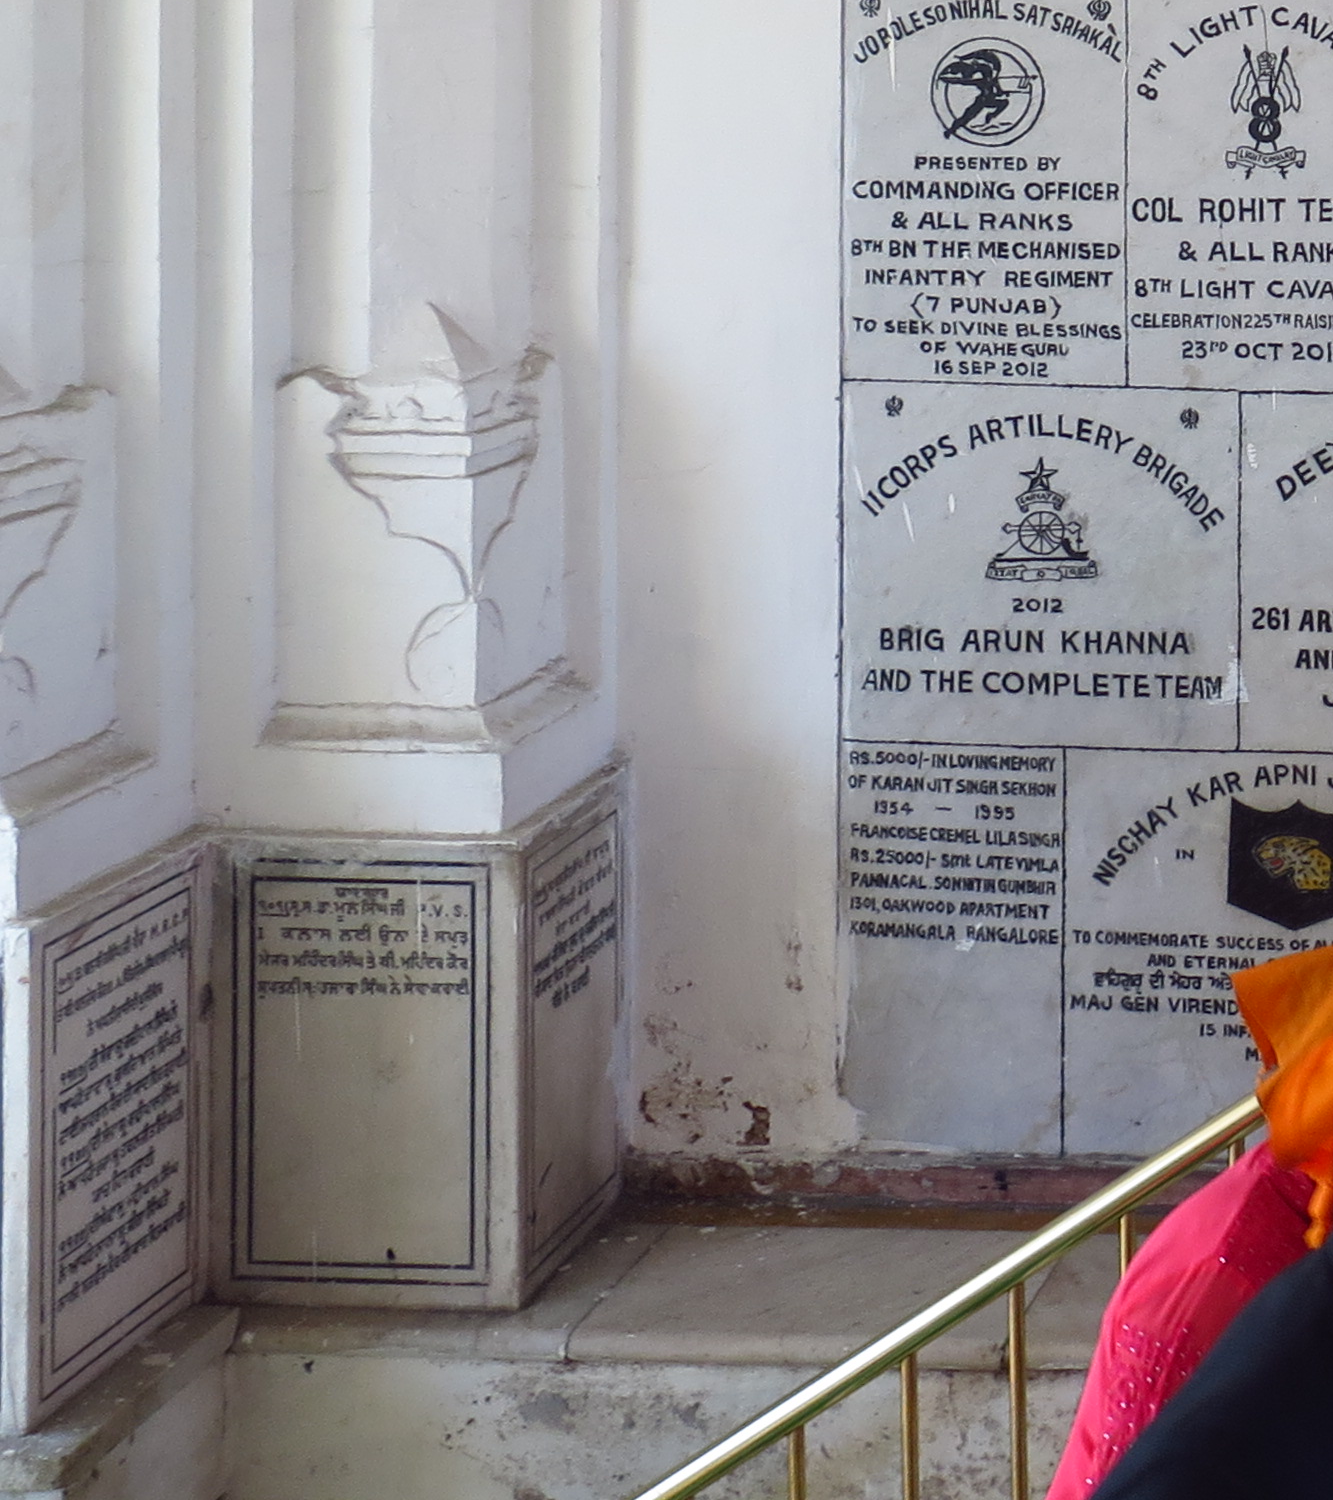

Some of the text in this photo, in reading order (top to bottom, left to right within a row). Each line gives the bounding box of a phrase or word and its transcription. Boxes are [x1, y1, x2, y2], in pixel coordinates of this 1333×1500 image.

[914, 156, 1060, 171] PRESENTED BY
[1132, 198, 1183, 222] COL
[1199, 198, 1286, 222] ROHIT
[1013, 598, 1063, 613] 2012
[1252, 607, 1289, 630] 261
[880, 625, 1190, 654] BRIG ARUN KHANNA
